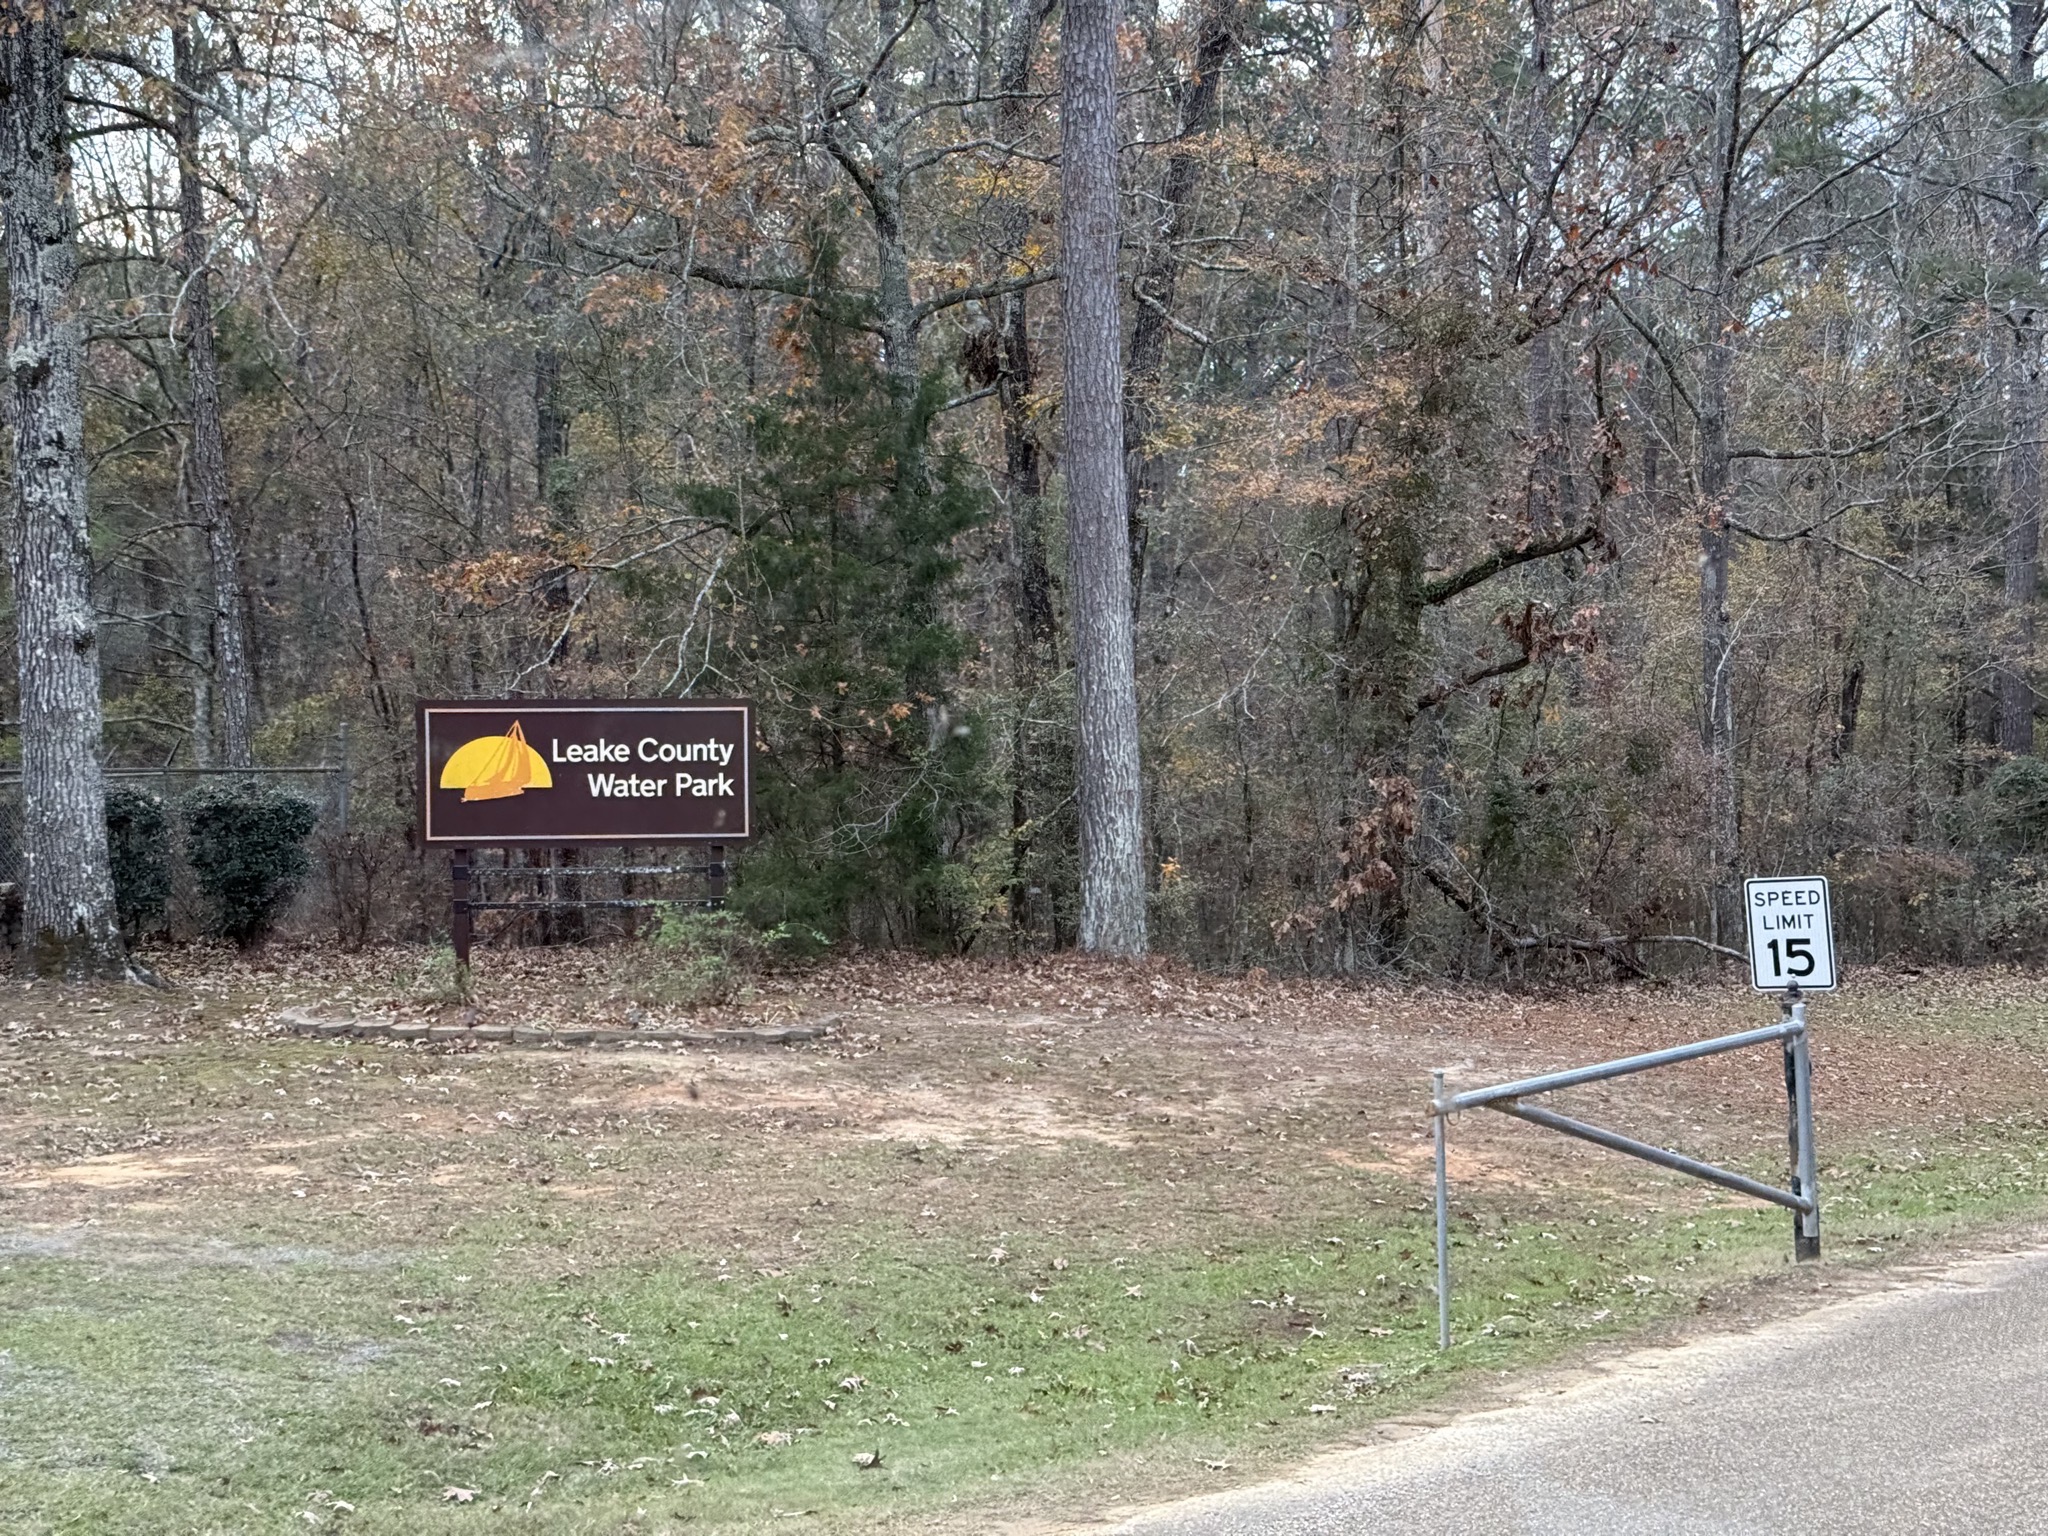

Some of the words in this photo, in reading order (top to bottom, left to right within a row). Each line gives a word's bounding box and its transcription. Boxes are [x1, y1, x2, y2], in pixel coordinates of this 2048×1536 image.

[552, 738, 631, 763] Leake
[637, 737, 735, 766] County
[587, 773, 667, 797] Water
[675, 772, 735, 797] Park
[1754, 890, 1820, 907] SPEED
[1763, 914, 1814, 930] LIMIT
[1767, 938, 1815, 977] 15
